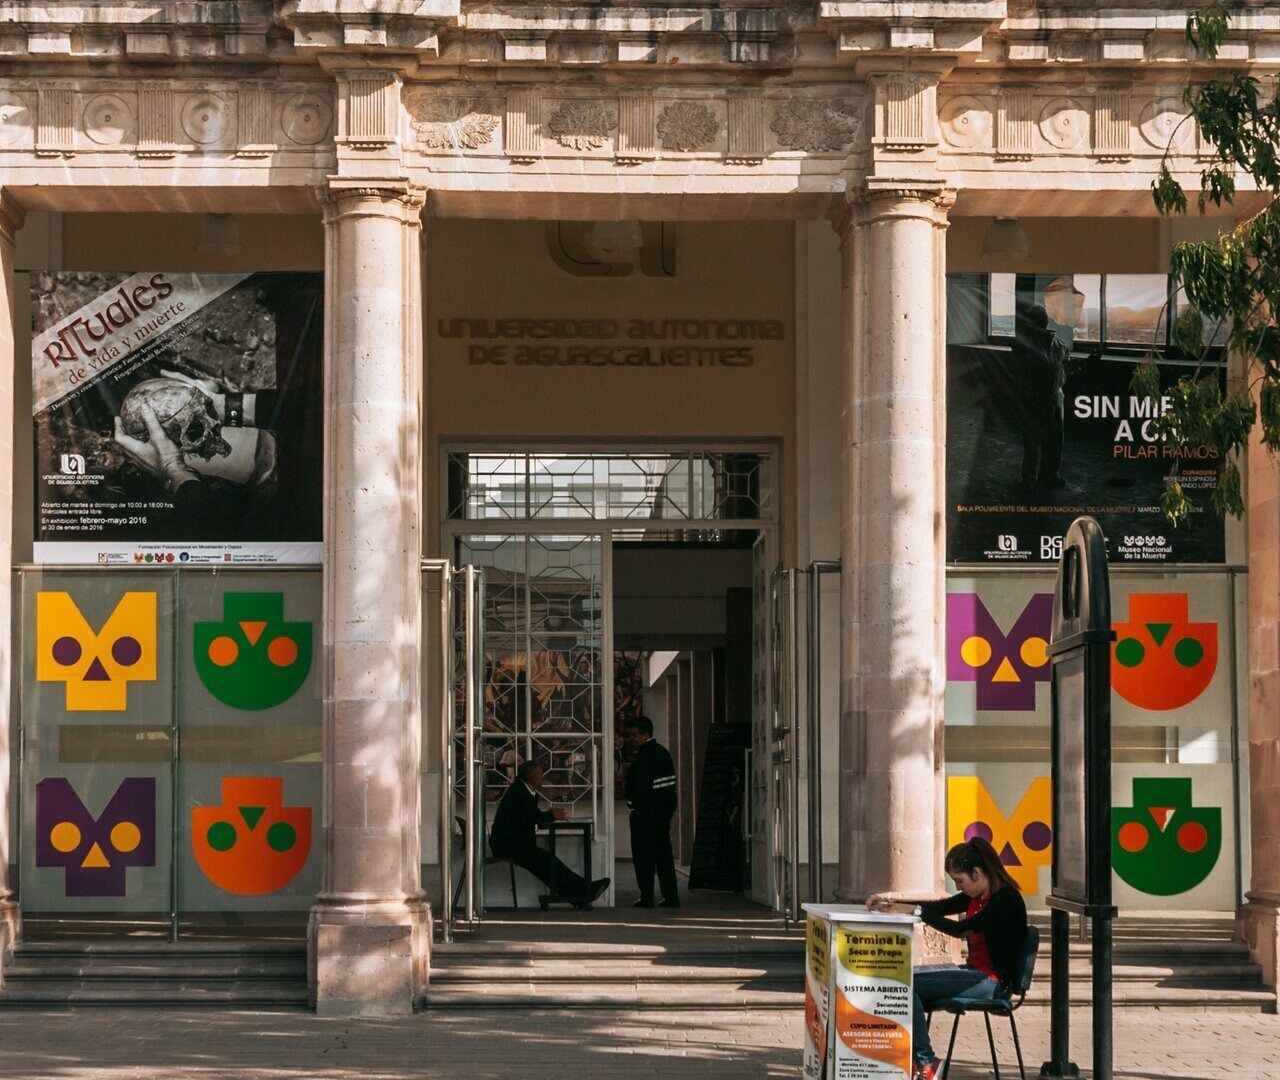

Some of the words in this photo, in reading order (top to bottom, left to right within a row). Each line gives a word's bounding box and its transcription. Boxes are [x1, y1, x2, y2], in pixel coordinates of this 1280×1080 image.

[68, 368, 87, 384] de
[88, 345, 120, 370] vida
[121, 336, 132, 354] y
[133, 300, 186, 341] muerte
[468, 345, 509, 366] DE
[513, 346, 755, 368] AGUASCALIENTES
[1074, 395, 1119, 418] SIN
[1114, 420, 1134, 442] A
[1113, 445, 1158, 458] PILAR
[1162, 445, 1219, 459] RAMOS
[80, 516, 127, 526] febrero-mayo
[128, 516, 147, 525] 2016
[1041, 535, 1063, 548] DG
[845, 934, 893, 945] Termina
[896, 934, 906, 945] la
[849, 947, 869, 956] Secu
[878, 948, 902, 958] Prepa
